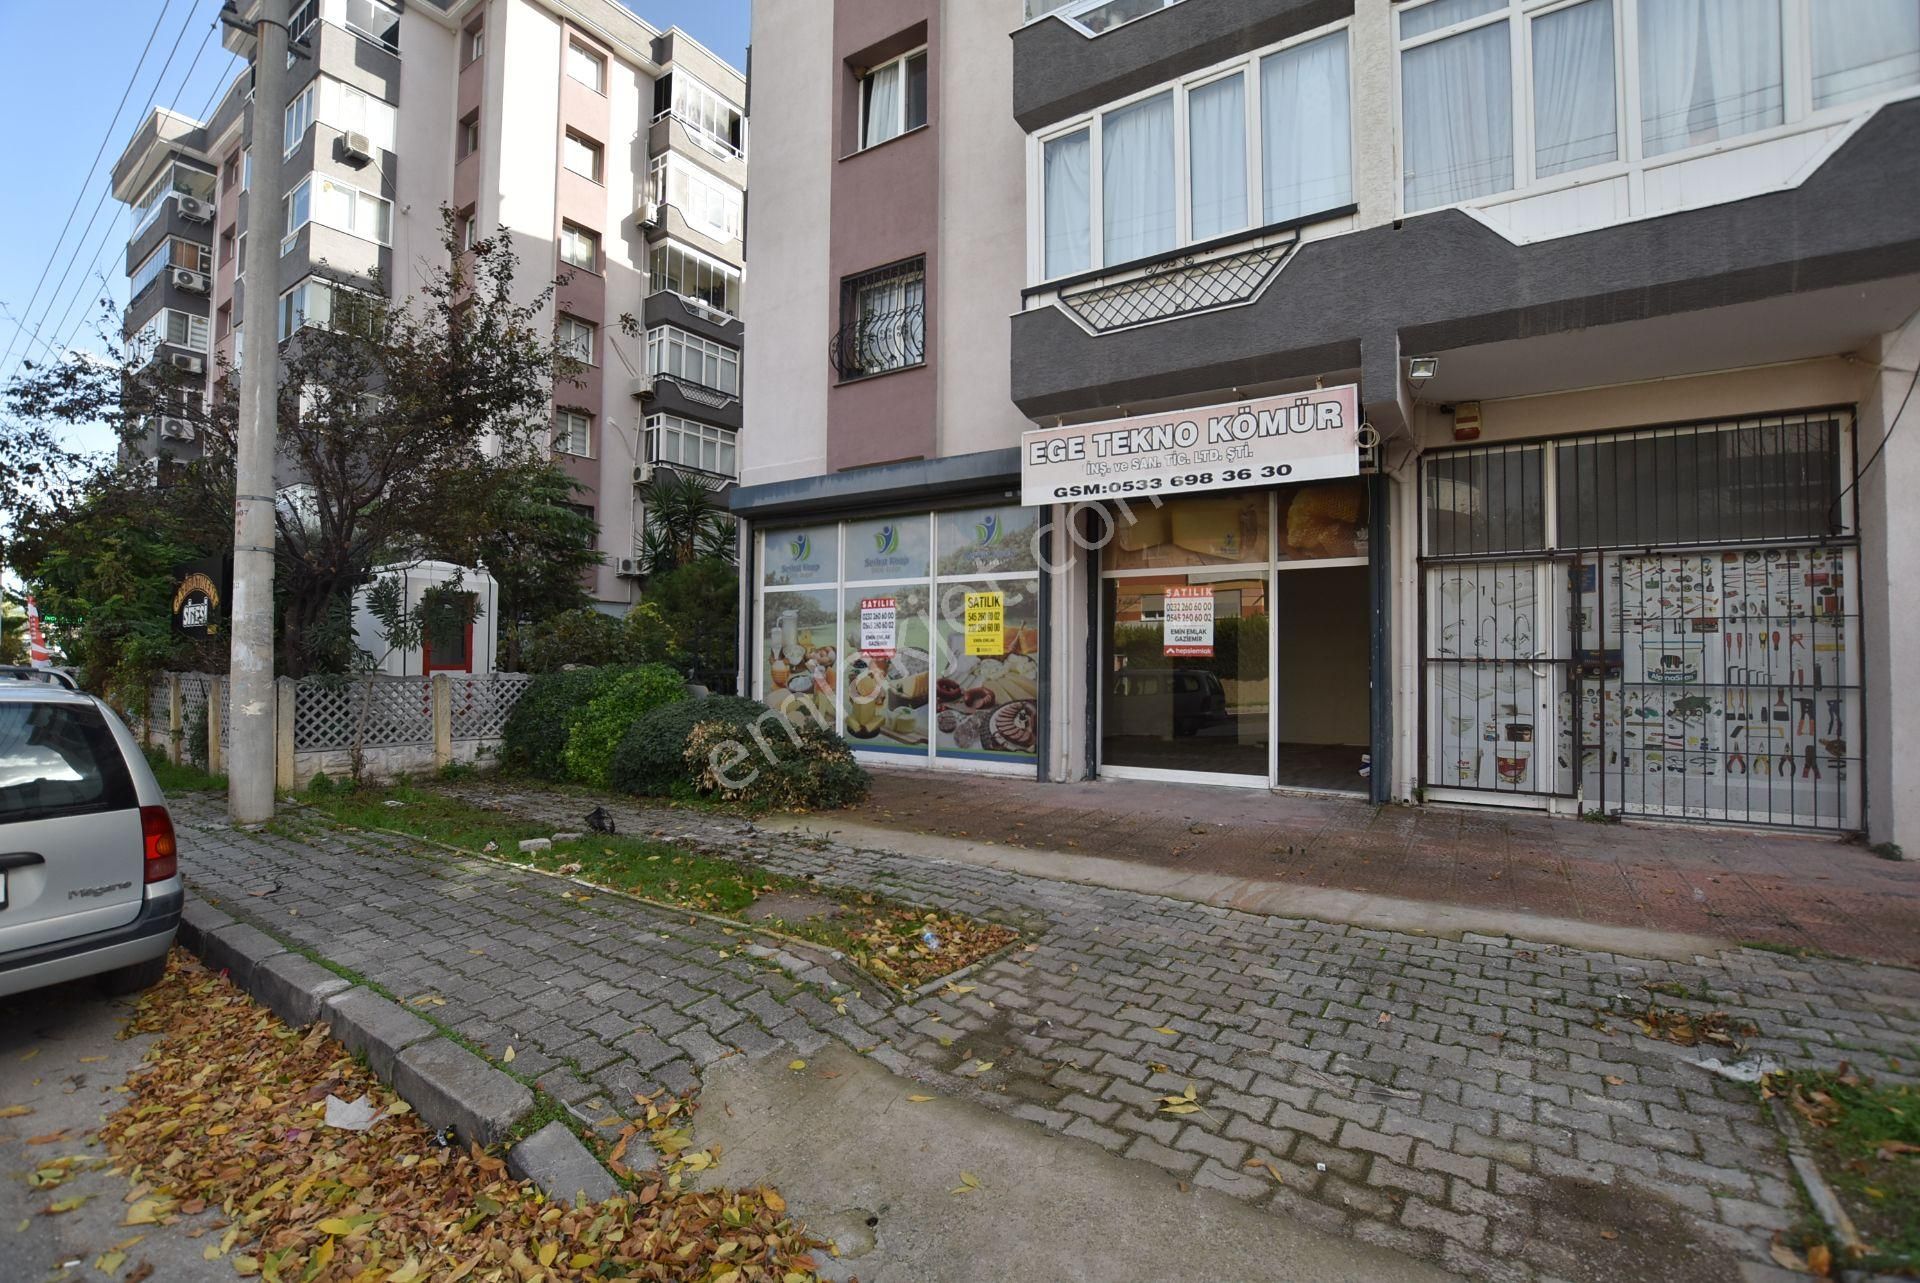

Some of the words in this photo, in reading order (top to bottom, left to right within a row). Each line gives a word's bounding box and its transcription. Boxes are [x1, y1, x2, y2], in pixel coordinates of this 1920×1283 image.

[1030, 436, 1086, 466] EGE
[1092, 420, 1199, 458] TEKNO
[1208, 397, 1343, 444] KÖMÜR
[1087, 460, 1111, 477] İNŞ.
[1114, 462, 1129, 472] ve
[1131, 456, 1161, 470] SAN.
[1165, 451, 1191, 467] TİC.
[1194, 449, 1222, 463] LTD.
[1226, 442, 1254, 463] ŞTİ.
[1053, 478, 1163, 498] GSM:0533
[1170, 472, 1214, 487] 698
[1222, 468, 1252, 482] 36
[1260, 464, 1293, 478] 30
[1166, 587, 1213, 597] SATILIK
[862, 599, 895, 609] SATILIK
[967, 596, 1001, 608] SATILIK
[1166, 603, 1181, 611] 0232
[1182, 602, 1193, 611] 260
[1194, 602, 1201, 611] 60
[1203, 602, 1212, 611] 00
[1166, 614, 1181, 622] 0545
[1182, 614, 1193, 622] 260
[1195, 614, 1202, 622] 60
[1204, 613, 1212, 622] 02
